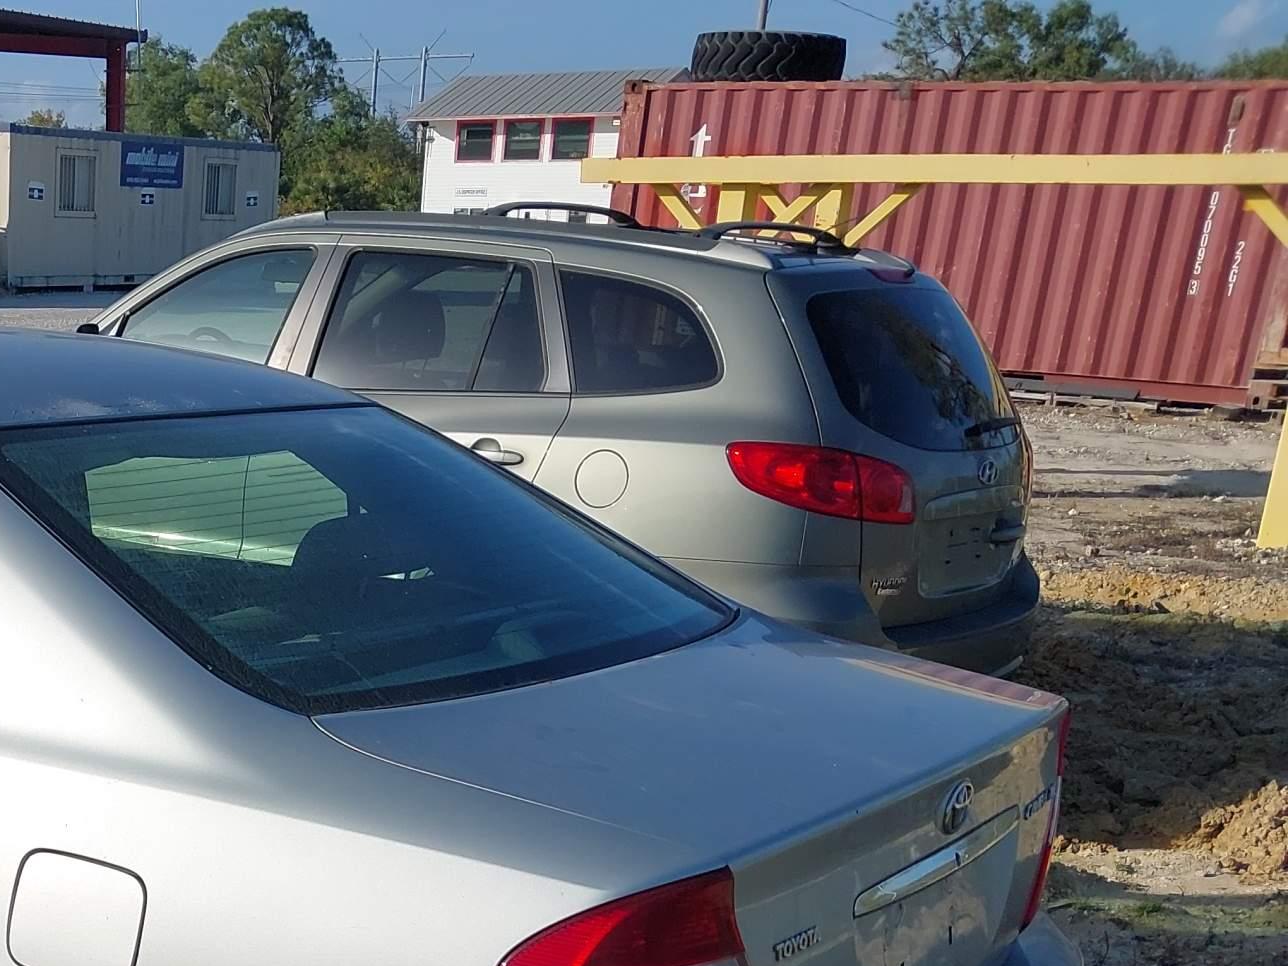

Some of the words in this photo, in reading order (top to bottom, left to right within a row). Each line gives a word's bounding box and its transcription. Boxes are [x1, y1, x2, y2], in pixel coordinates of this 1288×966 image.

[1194, 191, 1220, 275] 070095
[1228, 241, 1245, 296] 22G1
[774, 927, 822, 961] TOYOTA
